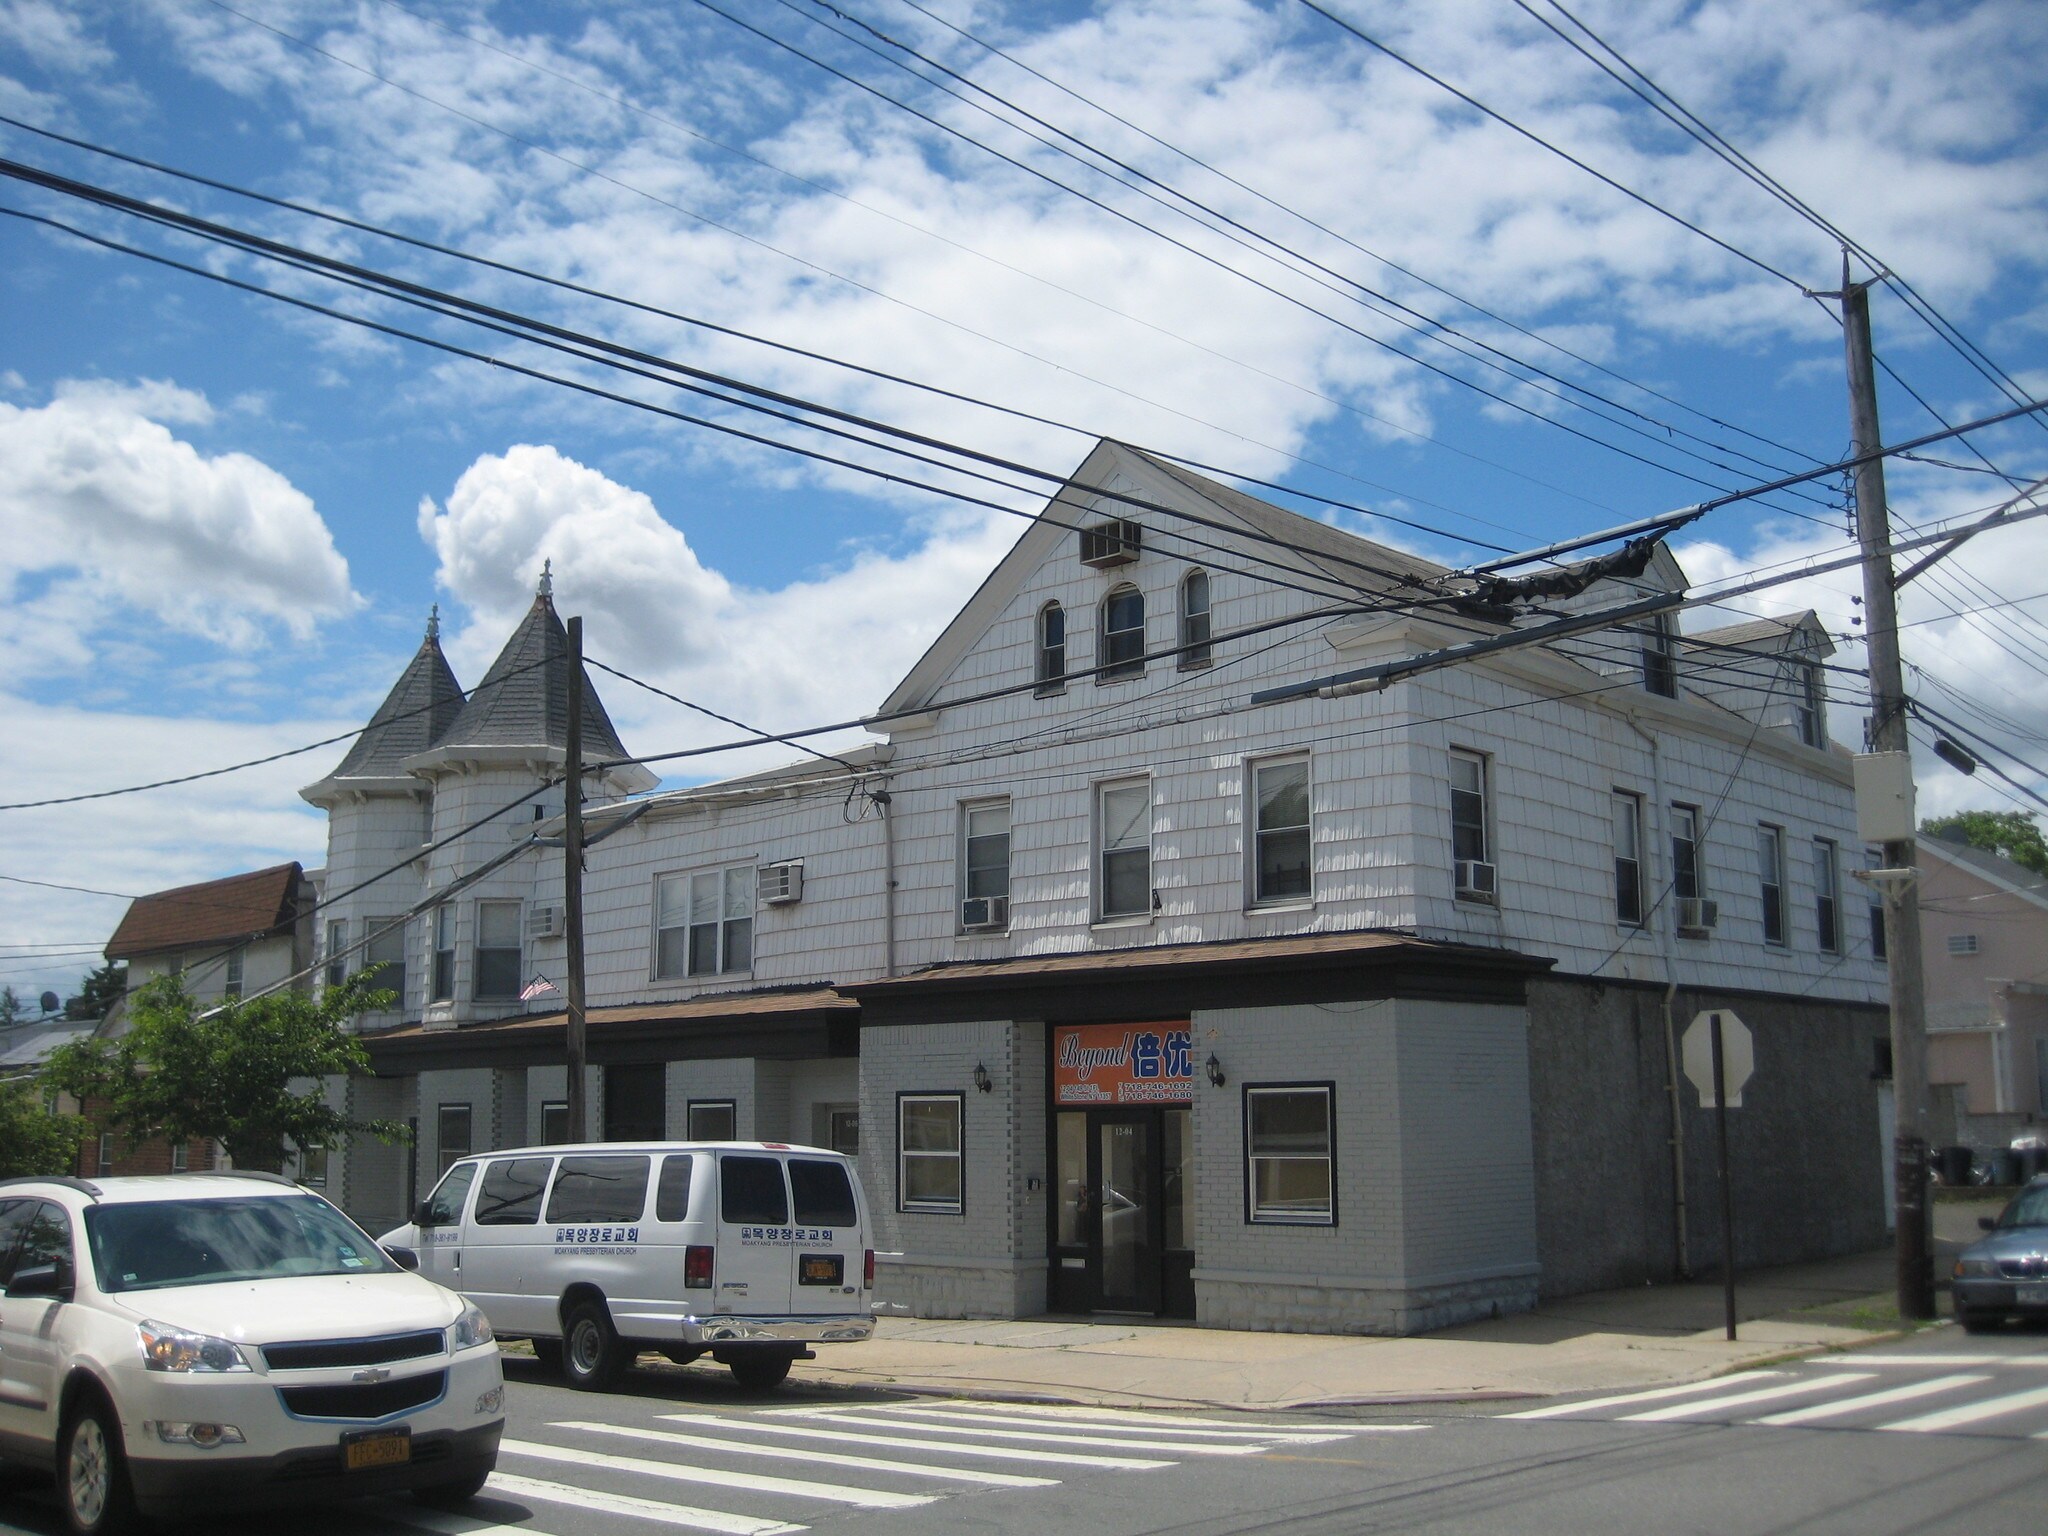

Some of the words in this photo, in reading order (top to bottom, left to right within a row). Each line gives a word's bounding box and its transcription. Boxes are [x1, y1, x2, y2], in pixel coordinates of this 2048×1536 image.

[1060, 1032, 1130, 1081] Beyond
[1130, 1031, 1192, 1078] 倍优
[1124, 1082, 1192, 1091] 718-746-1692
[1124, 1091, 1192, 1100] 718-746-1680
[1115, 1127, 1133, 1136] 12-04
[565, 1227, 639, 1243] 목양장로교회
[752, 1228, 833, 1242] 목양장로교회
[580, 1247, 615, 1255] PRESBYTERIAN
[616, 1247, 637, 1255] CHURCH
